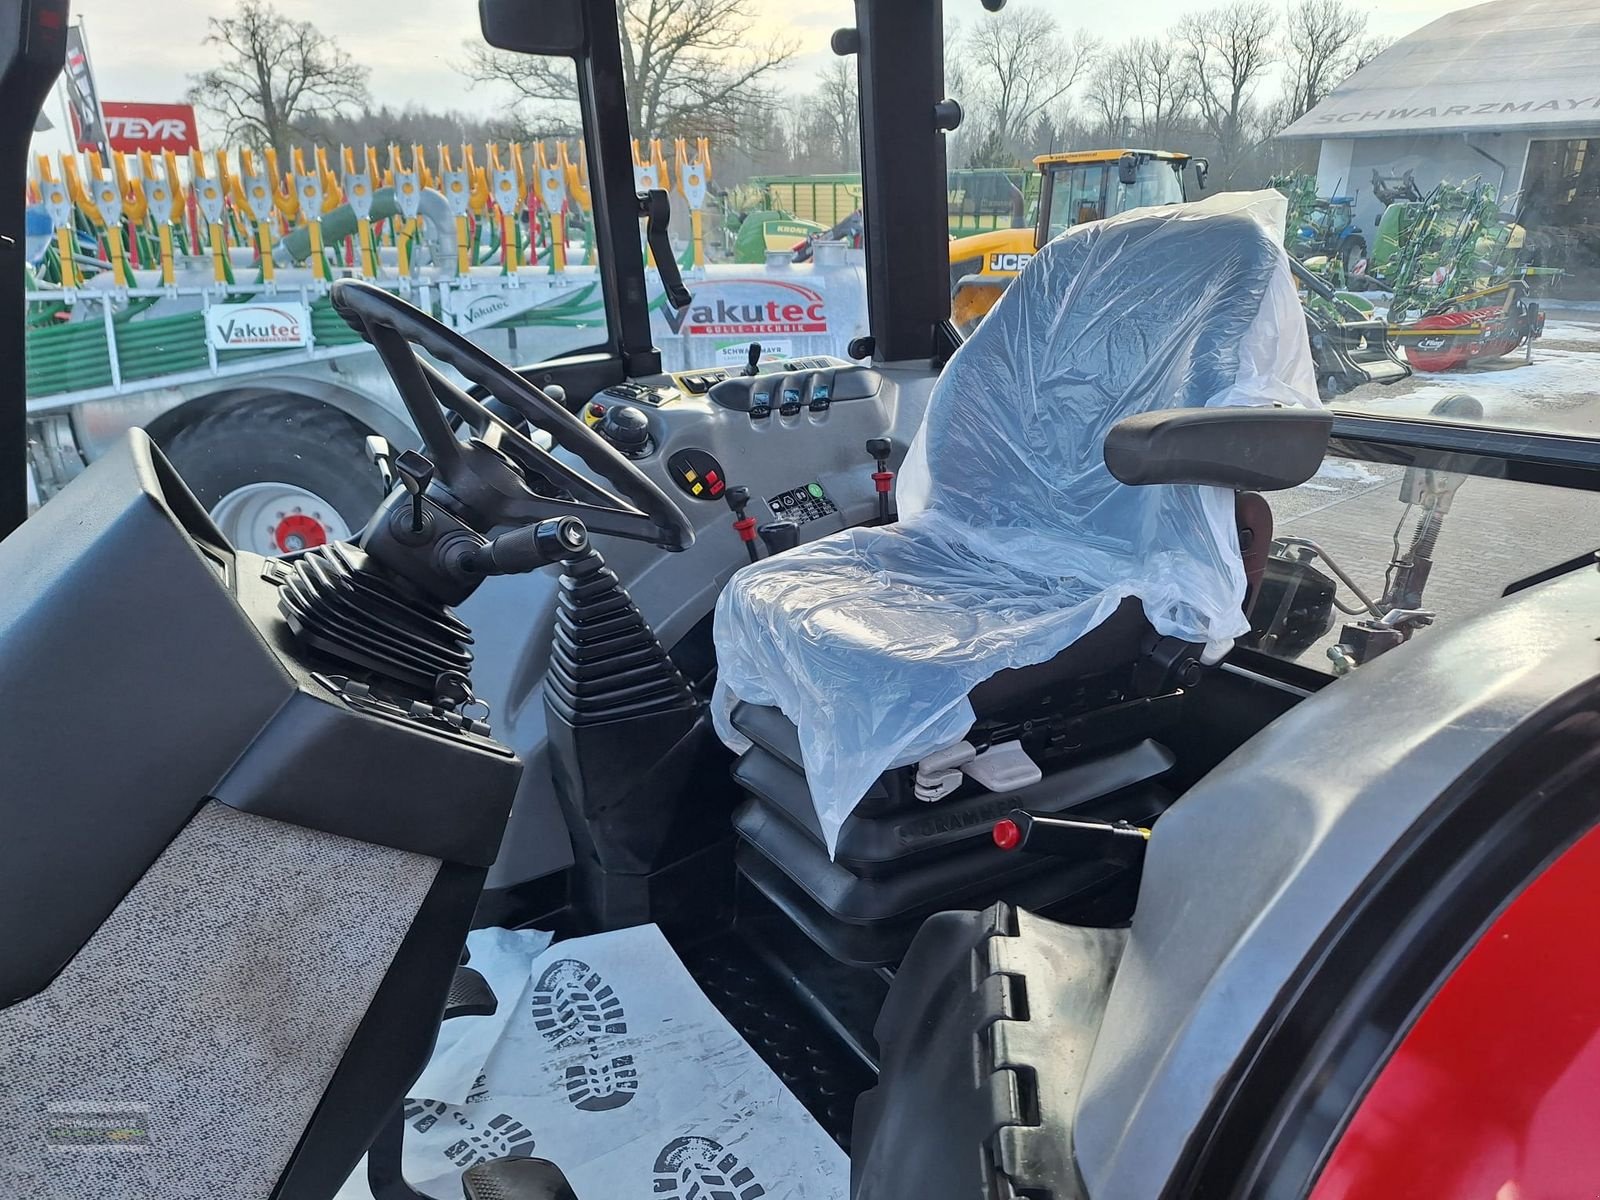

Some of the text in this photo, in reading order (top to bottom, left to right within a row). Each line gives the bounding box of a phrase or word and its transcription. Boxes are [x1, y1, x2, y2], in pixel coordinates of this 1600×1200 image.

[103, 116, 187, 140] TEYR
[777, 225, 808, 234] KRONE
[463, 301, 509, 323] Vakutec
[659, 292, 827, 335] Vakutec
[216, 319, 300, 343] Vakutec
